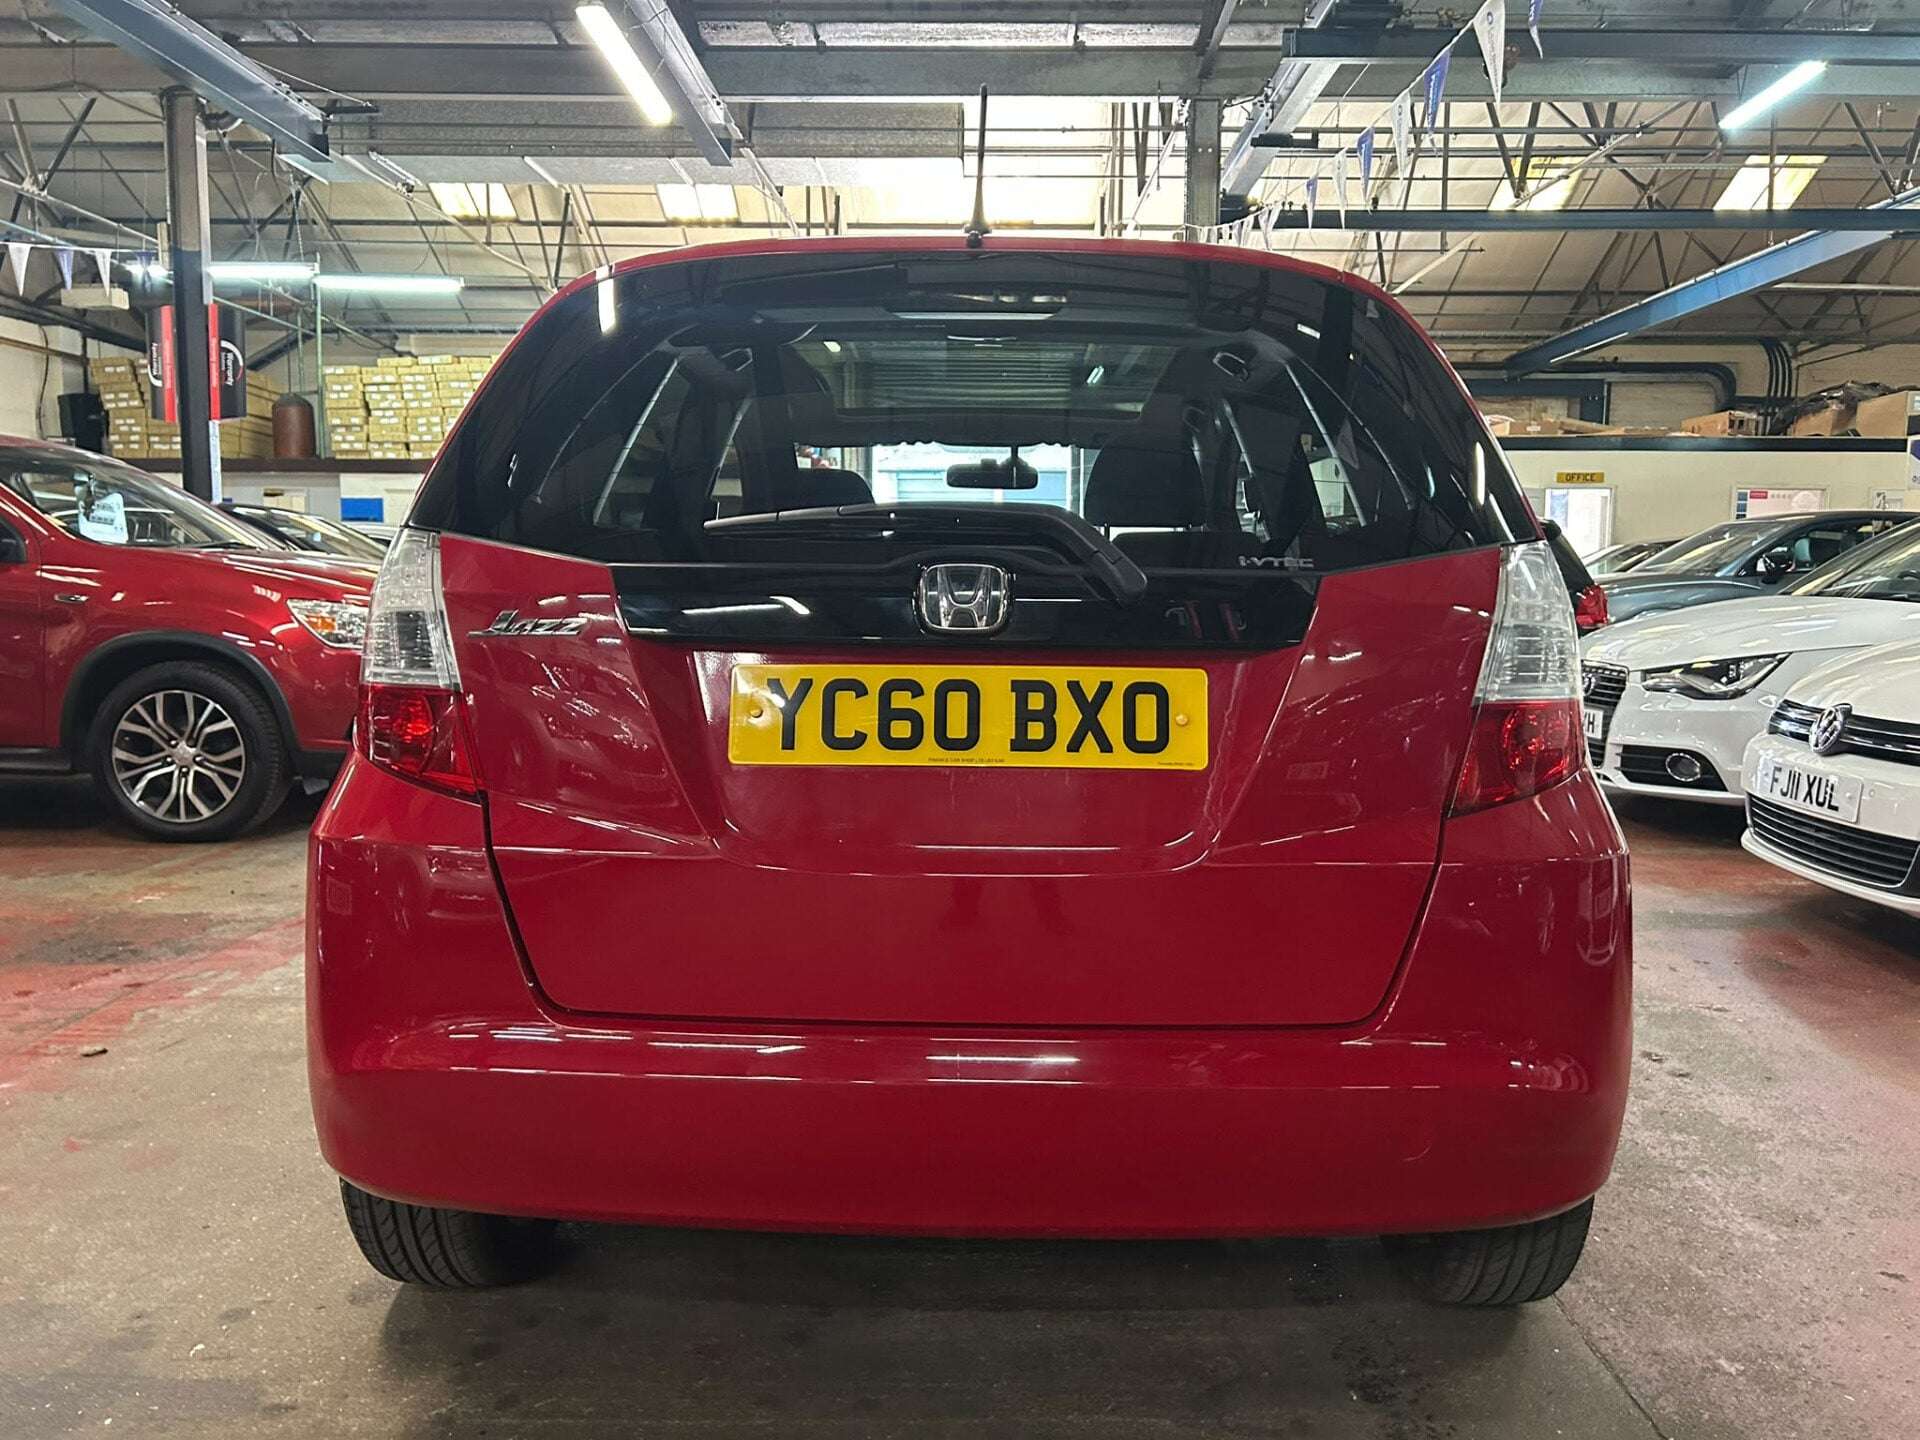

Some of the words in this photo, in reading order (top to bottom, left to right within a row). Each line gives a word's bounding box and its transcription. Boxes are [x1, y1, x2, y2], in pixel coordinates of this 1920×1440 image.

[1565, 472, 1597, 482] OFFICE
[767, 678, 981, 752] YC60
[1009, 679, 1171, 754] BXO
[1770, 766, 1802, 801] FJ11
[1803, 774, 1840, 812] XUL
